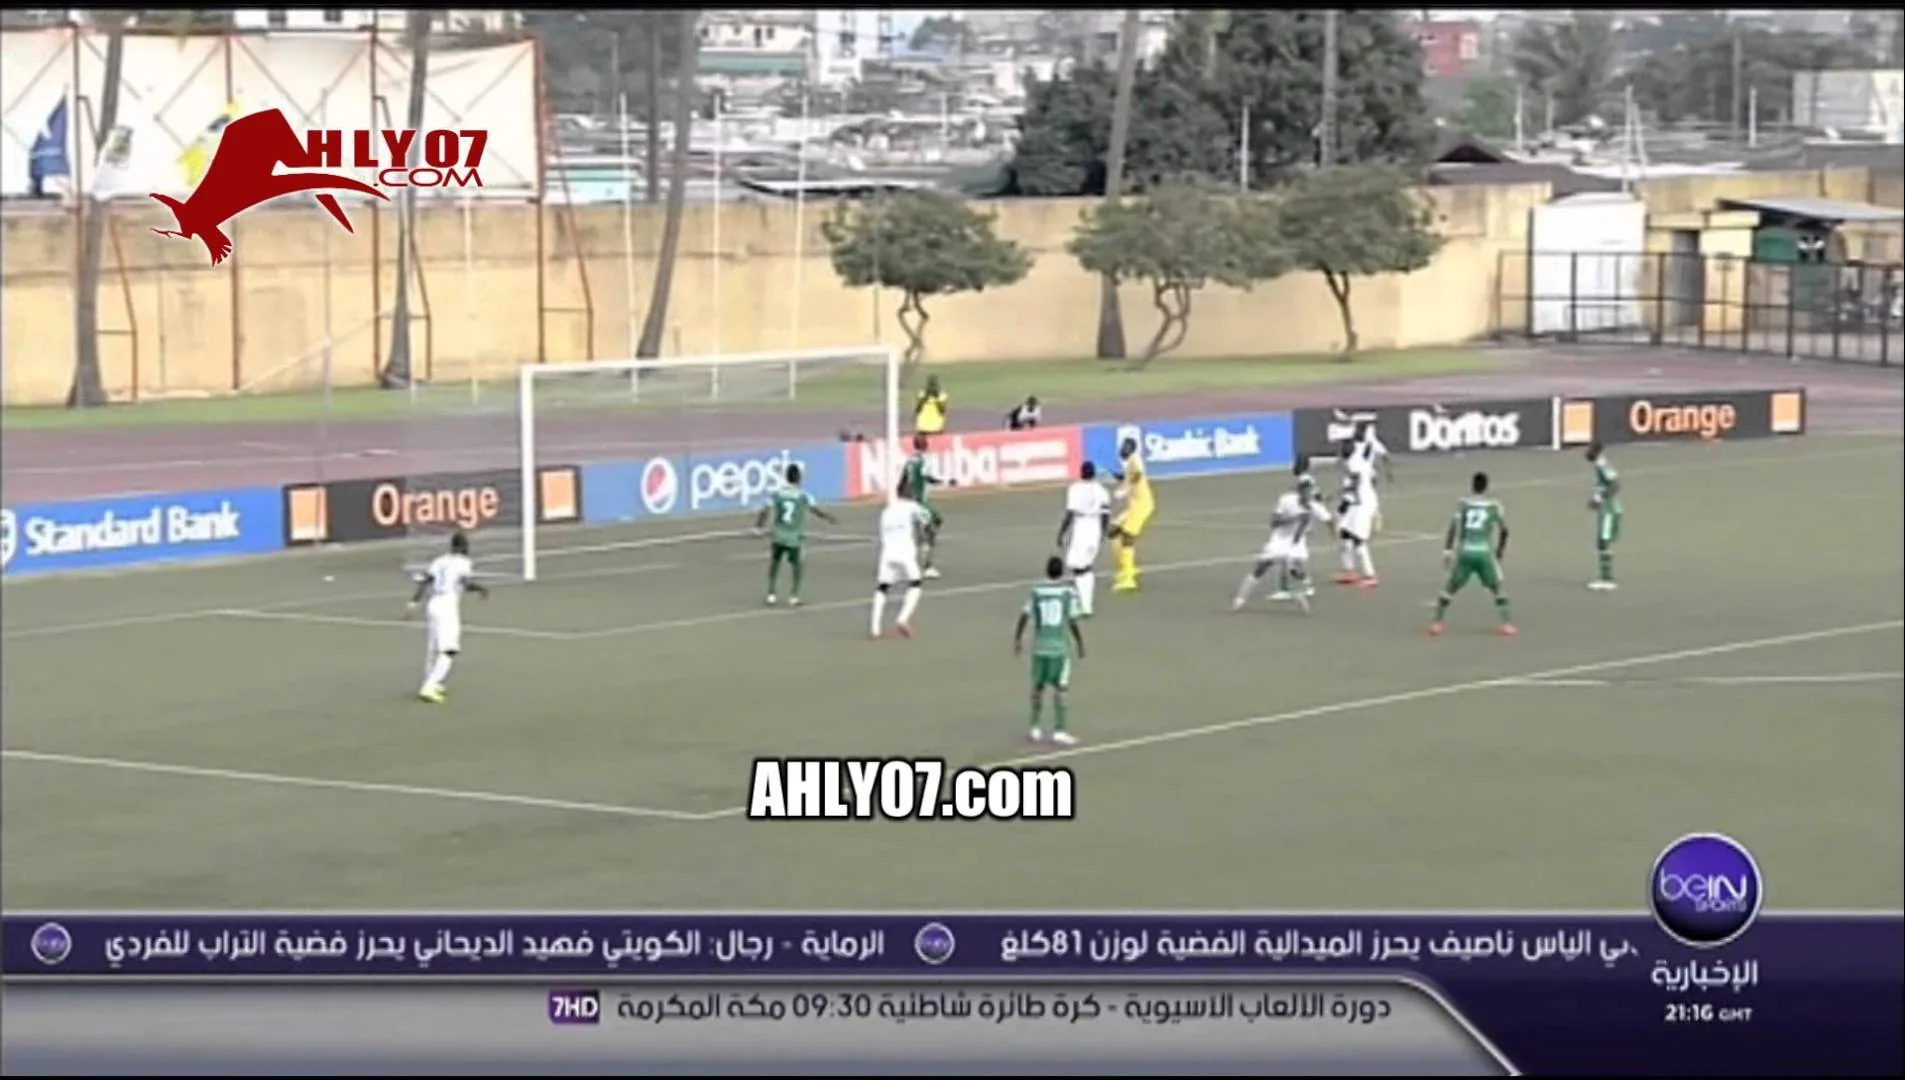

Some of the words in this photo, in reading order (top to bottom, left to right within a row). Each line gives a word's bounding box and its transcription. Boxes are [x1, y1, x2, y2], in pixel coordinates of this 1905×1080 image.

[1408, 404, 1520, 450] Doritos
[1630, 400, 1737, 437] Orange
[372, 483, 499, 528] Orange
[781, 501, 796, 524] 2
[25, 505, 164, 556] Standard
[167, 501, 240, 542] Bank
[1039, 599, 1062, 626] 10
